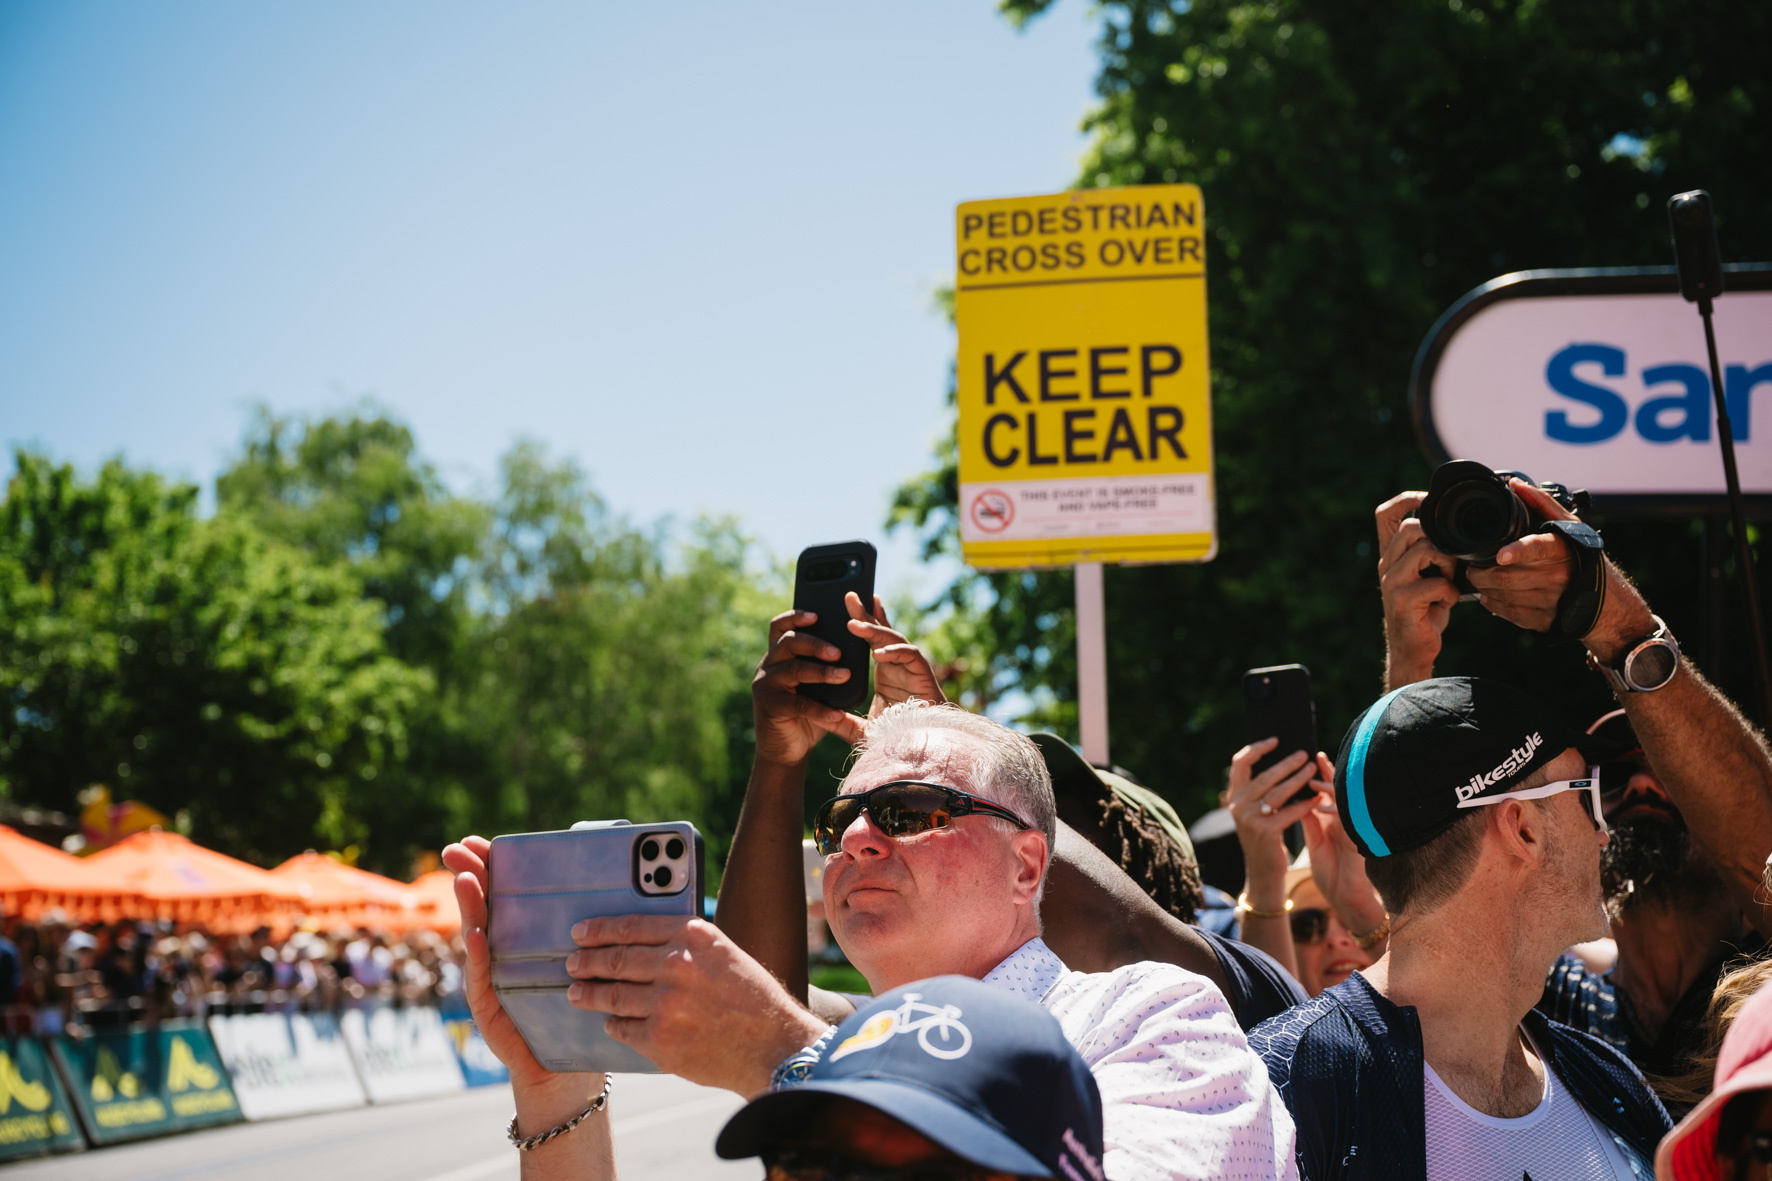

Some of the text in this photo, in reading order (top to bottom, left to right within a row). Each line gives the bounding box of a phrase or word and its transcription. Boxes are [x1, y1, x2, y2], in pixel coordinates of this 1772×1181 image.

[963, 202, 1196, 240] PEDESTRIAN
[959, 236, 1203, 276] CROSS OVER
[984, 344, 1183, 406] KEEP
[982, 404, 1189, 469] CLEAR
[1454, 731, 1543, 801] bikestyle
